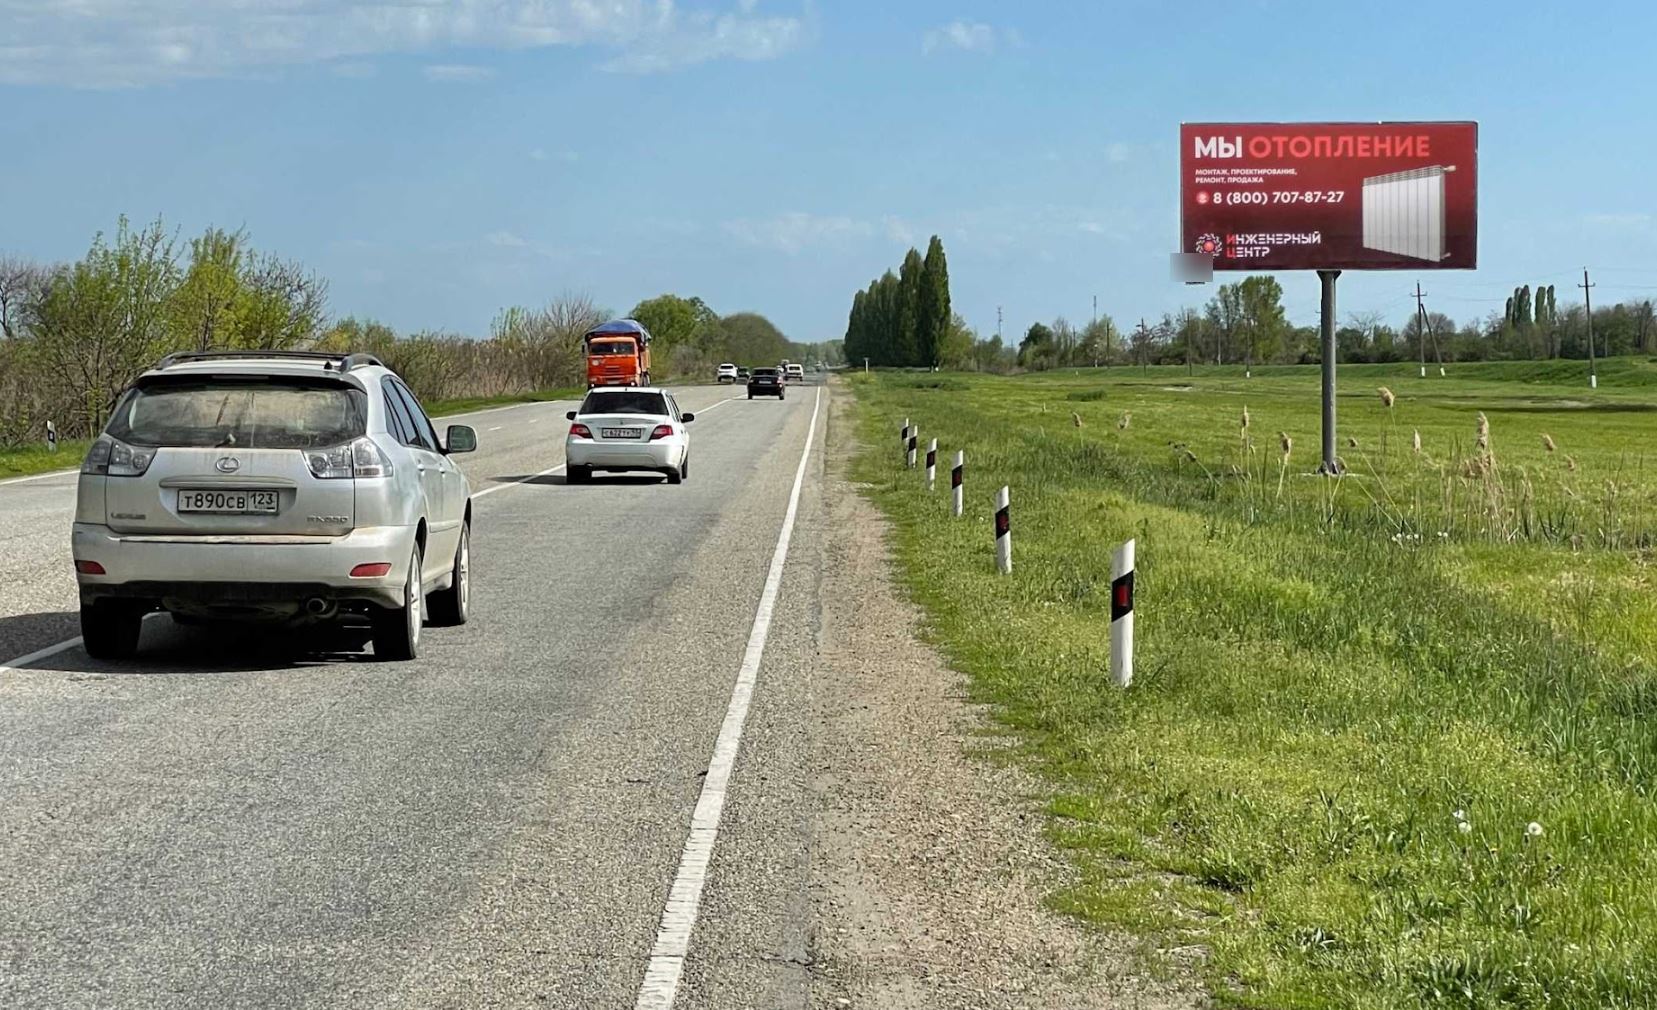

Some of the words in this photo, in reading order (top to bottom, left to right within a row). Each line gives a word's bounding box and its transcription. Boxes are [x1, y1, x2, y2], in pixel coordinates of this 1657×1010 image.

[1195, 136, 1242, 158] МЫ
[1249, 136, 1430, 158] ОТОПЛЕНИЕ
[1231, 168, 1298, 176] ПРОЕКТИРОВАНИЕ,
[1213, 192, 1222, 204] 8
[1226, 192, 1268, 205] (800)
[1272, 191, 1344, 204] 707-87-27
[1226, 231, 1321, 245] ИНЖЕНЕРНЫЙ
[1226, 247, 1270, 259] ЦЕНТР
[251, 493, 274, 505] 123
